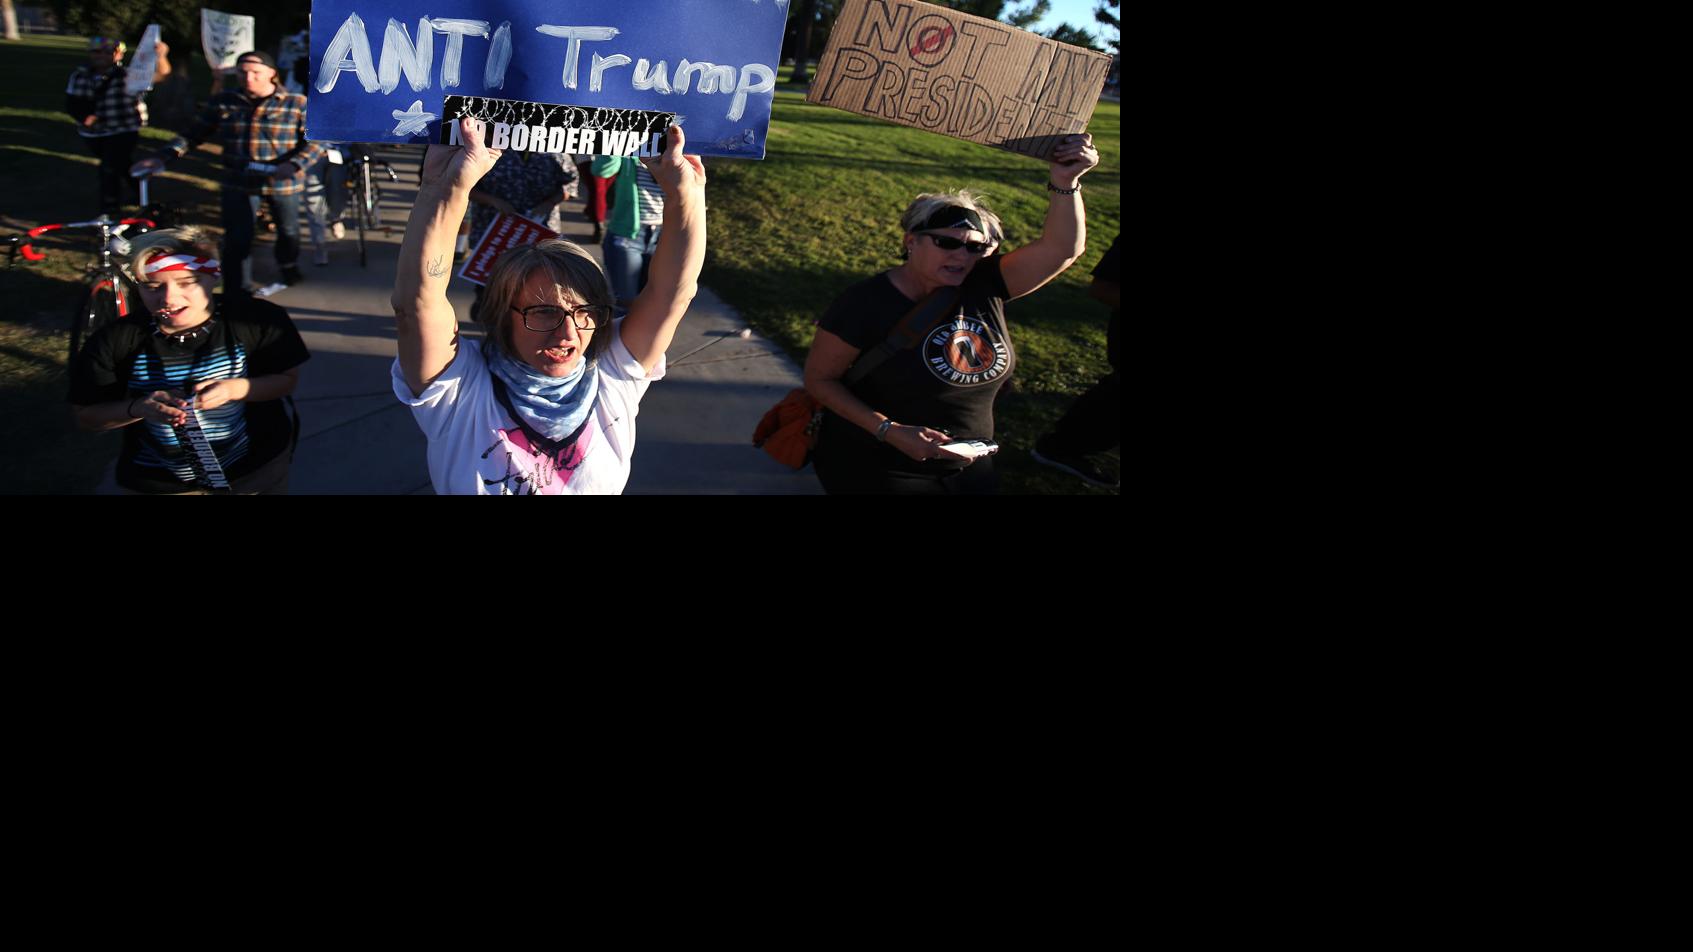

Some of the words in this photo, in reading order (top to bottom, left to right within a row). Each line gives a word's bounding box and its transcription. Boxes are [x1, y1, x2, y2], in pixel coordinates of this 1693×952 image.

[314, 12, 513, 95] ANTI
[536, 24, 776, 122] Trump
[853, 0, 1010, 80] NOT
[1015, 42, 1111, 115] MY
[491, 120, 596, 155] BORDER
[601, 129, 664, 159] WALL
[489, 235, 503, 247] to
[930, 356, 979, 384] BREWING
[983, 342, 1008, 381] COMPANY
[187, 431, 221, 472] BORDER
